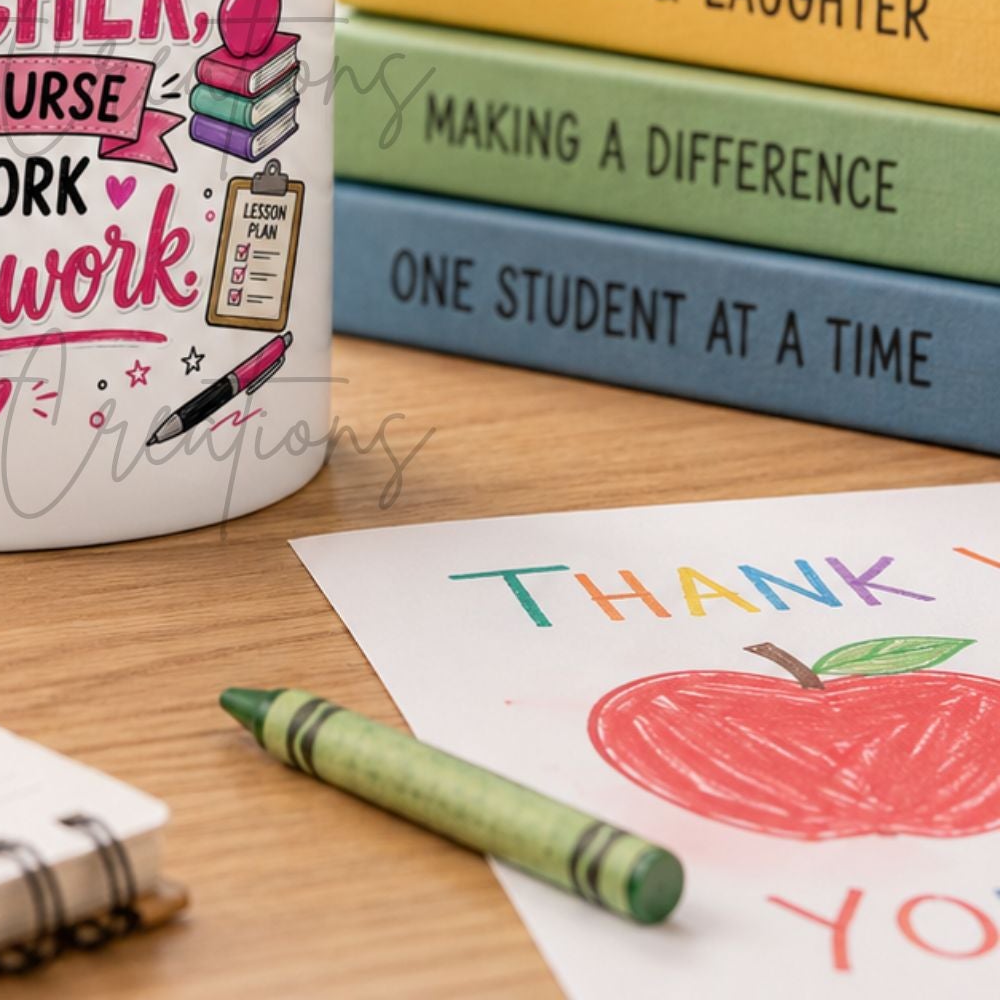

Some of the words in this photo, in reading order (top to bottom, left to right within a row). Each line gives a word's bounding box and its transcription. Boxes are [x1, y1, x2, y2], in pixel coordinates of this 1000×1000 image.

[424, 93, 582, 164] MAKING
[599, 120, 626, 172] A
[647, 125, 899, 214] DIFFERENCE
[243, 203, 288, 221] LESSON
[247, 222, 279, 240] PLAN
[391, 250, 475, 313] ONE
[497, 266, 686, 346] STUDENT
[705, 300, 756, 359] AT
[777, 311, 804, 368] A
[826, 317, 932, 388] TIME
[449, 557, 936, 628] THANK
[766, 888, 1000, 972] YO
